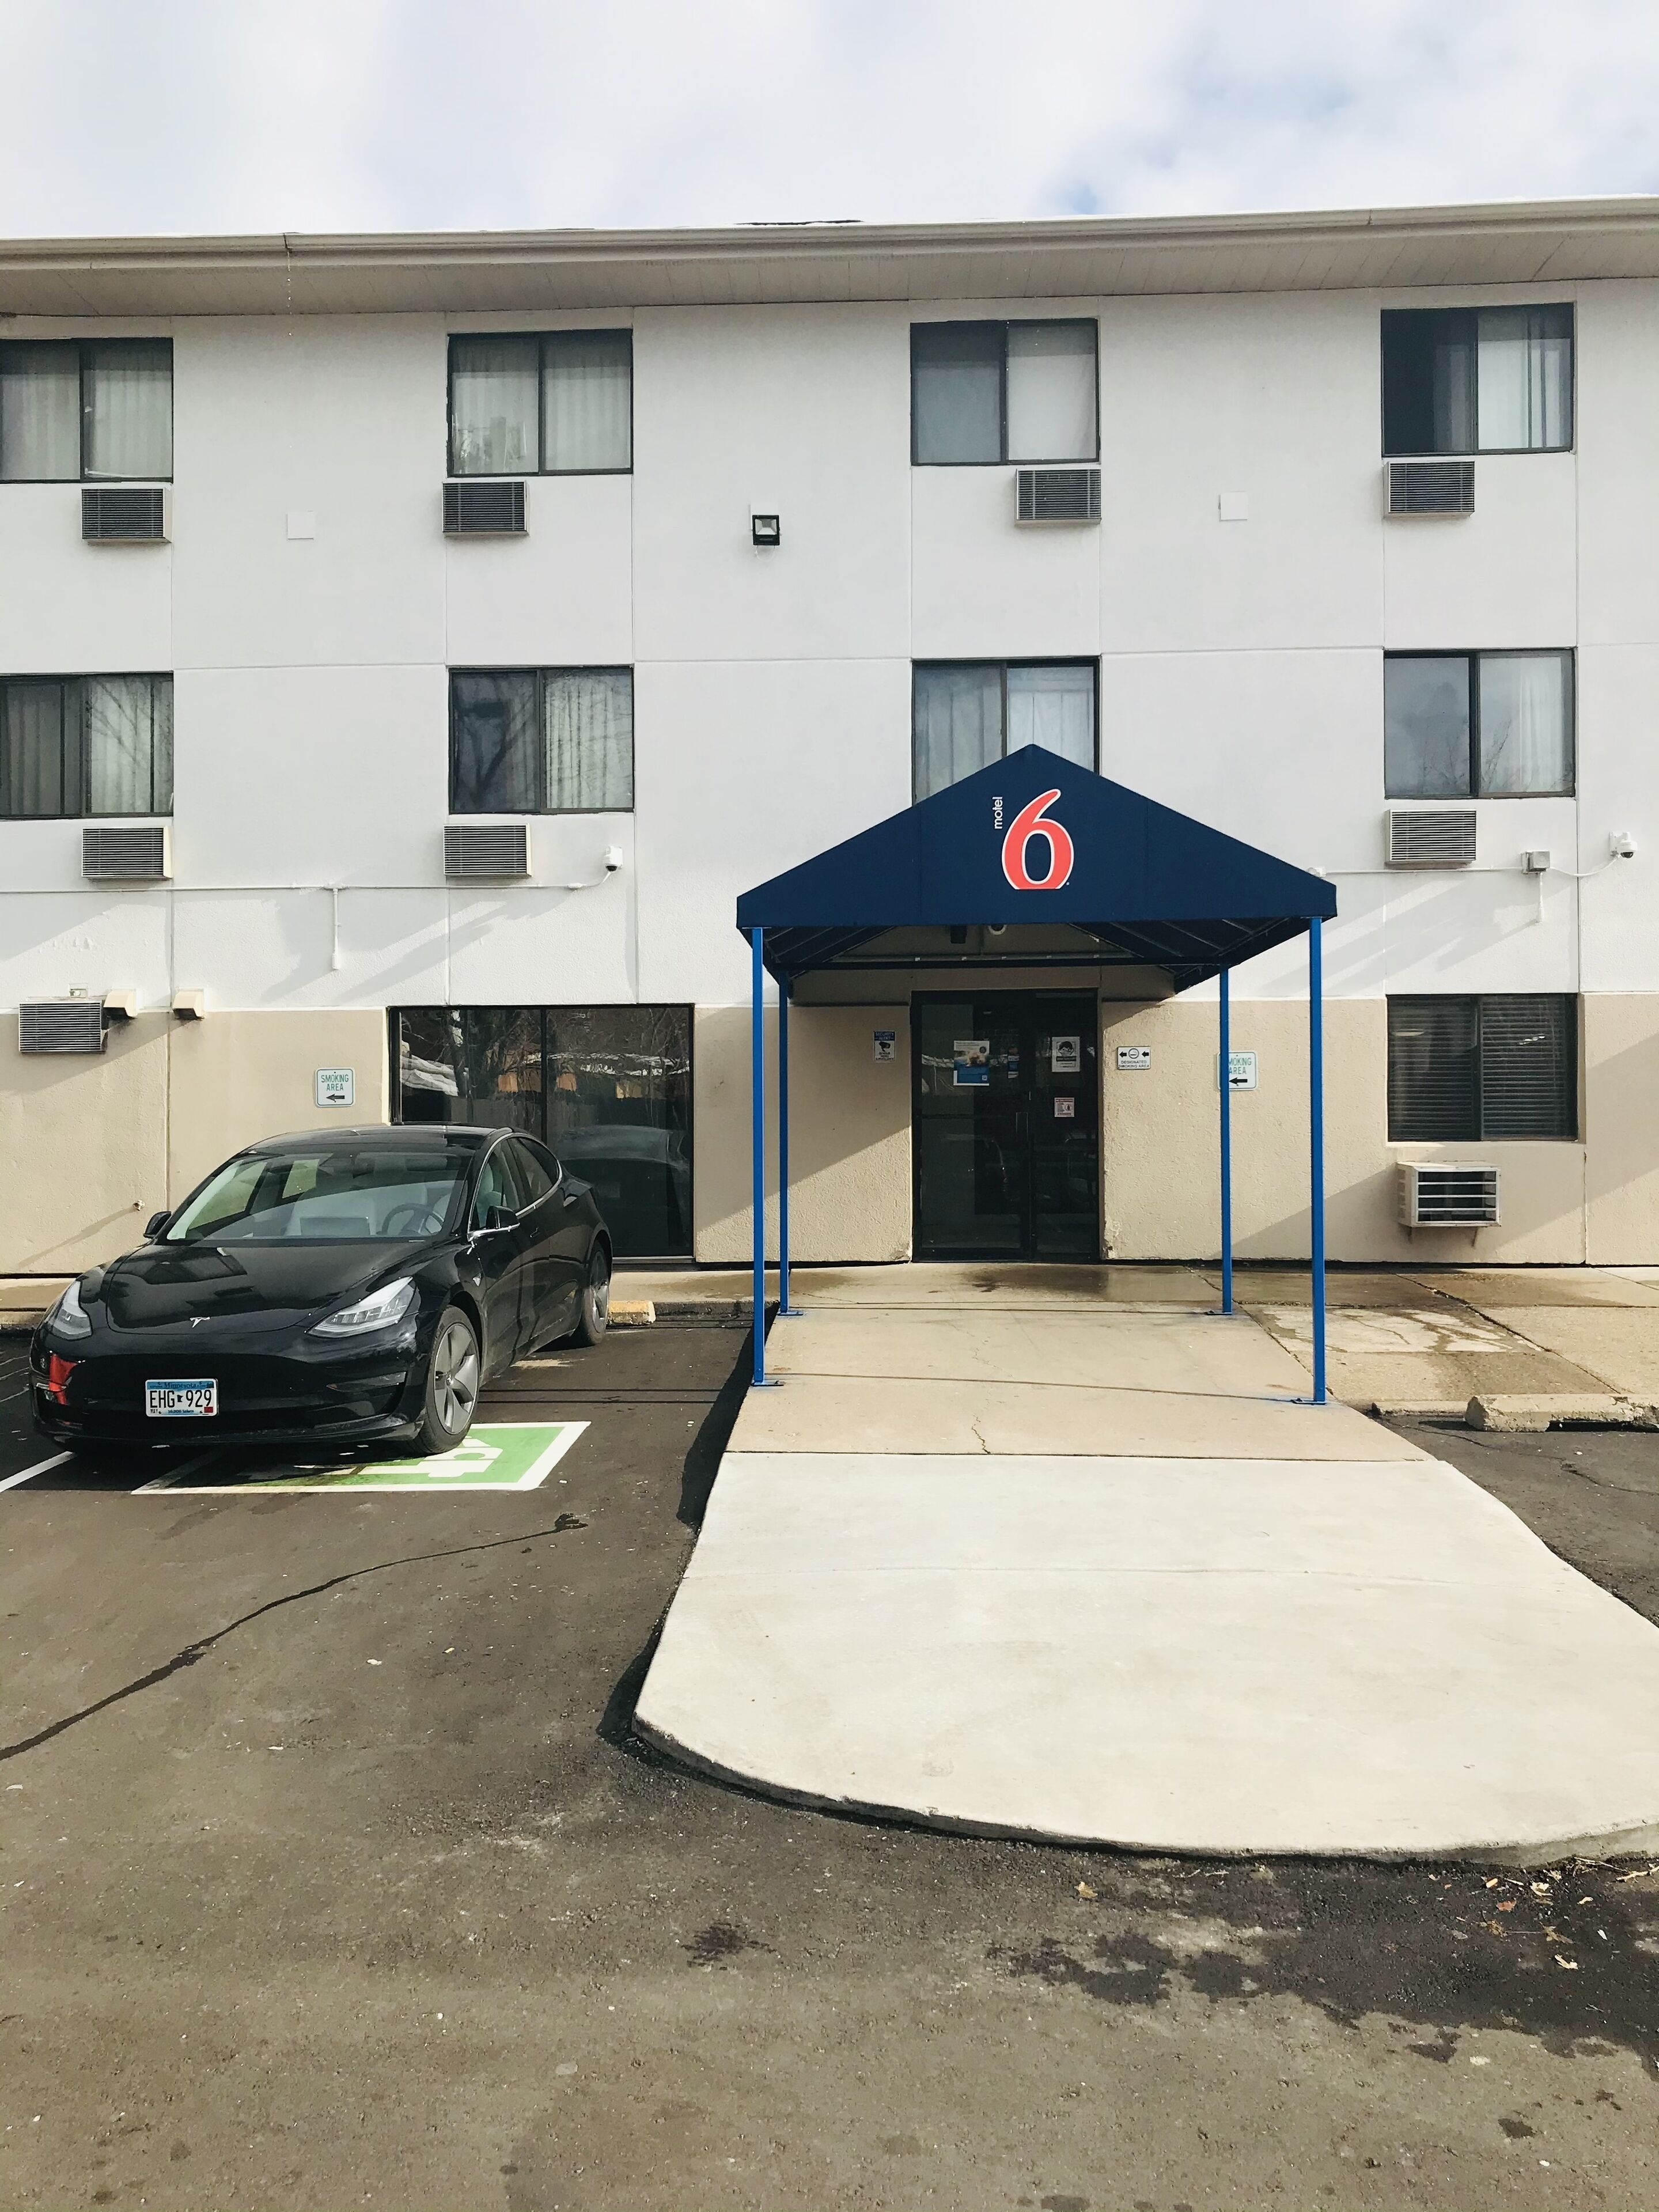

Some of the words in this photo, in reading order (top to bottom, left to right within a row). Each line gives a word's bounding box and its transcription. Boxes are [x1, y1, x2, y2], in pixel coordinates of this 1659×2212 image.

[992, 797, 1003, 829] motel
[1002, 789, 1074, 890] 6
[1228, 1058, 1252, 1066] MOKING
[321, 1074, 349, 1083] SMOKING
[326, 1083, 344, 1091] AREA
[150, 1390, 175, 1408] EHG
[185, 1389, 212, 1407] 929
